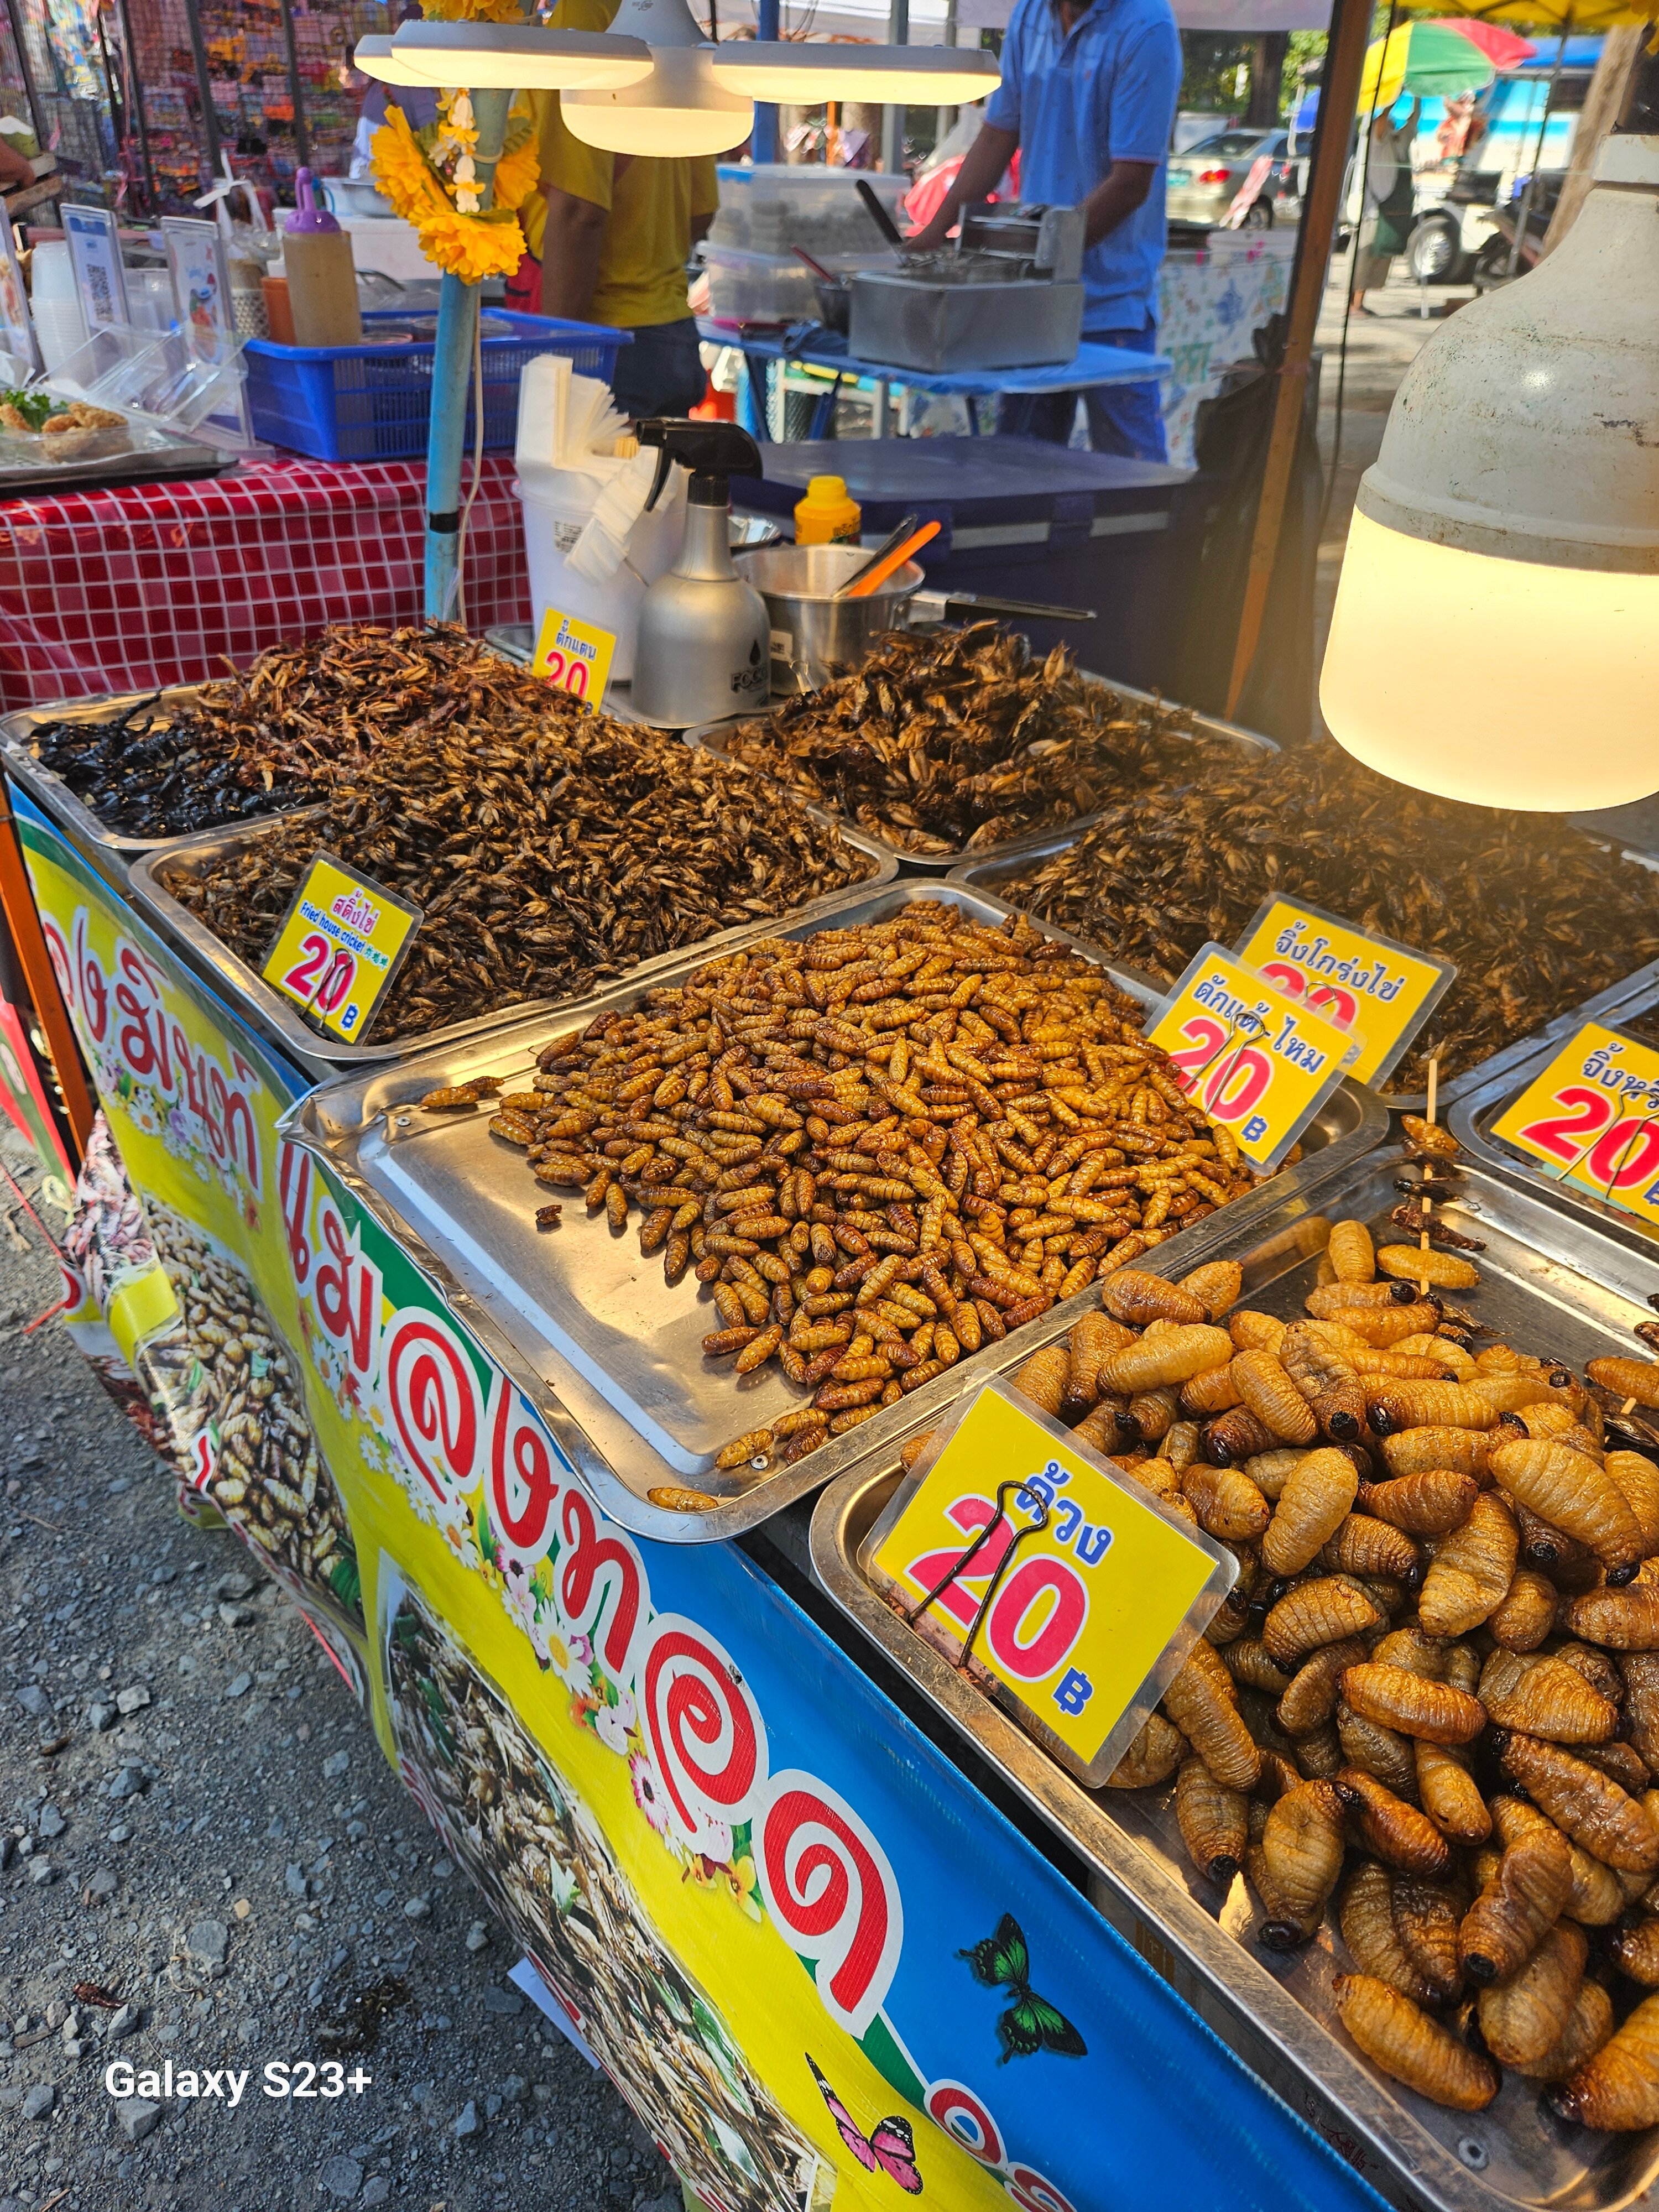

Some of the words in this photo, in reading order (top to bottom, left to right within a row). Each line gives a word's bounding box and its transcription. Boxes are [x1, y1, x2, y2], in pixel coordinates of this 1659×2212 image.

[545, 651, 587, 698] 20
[300, 902, 321, 922] Fried
[319, 914, 341, 937] house
[341, 932, 366, 953] cricket
[1276, 921, 1405, 1000] จิ้งโกร่งไข่
[285, 935, 354, 1011] 20
[1164, 1019, 1271, 1120] 20
[1521, 1088, 1659, 1187] 20
[1016, 1463, 1112, 1566] ด้วง
[909, 1498, 1086, 1678] 20
